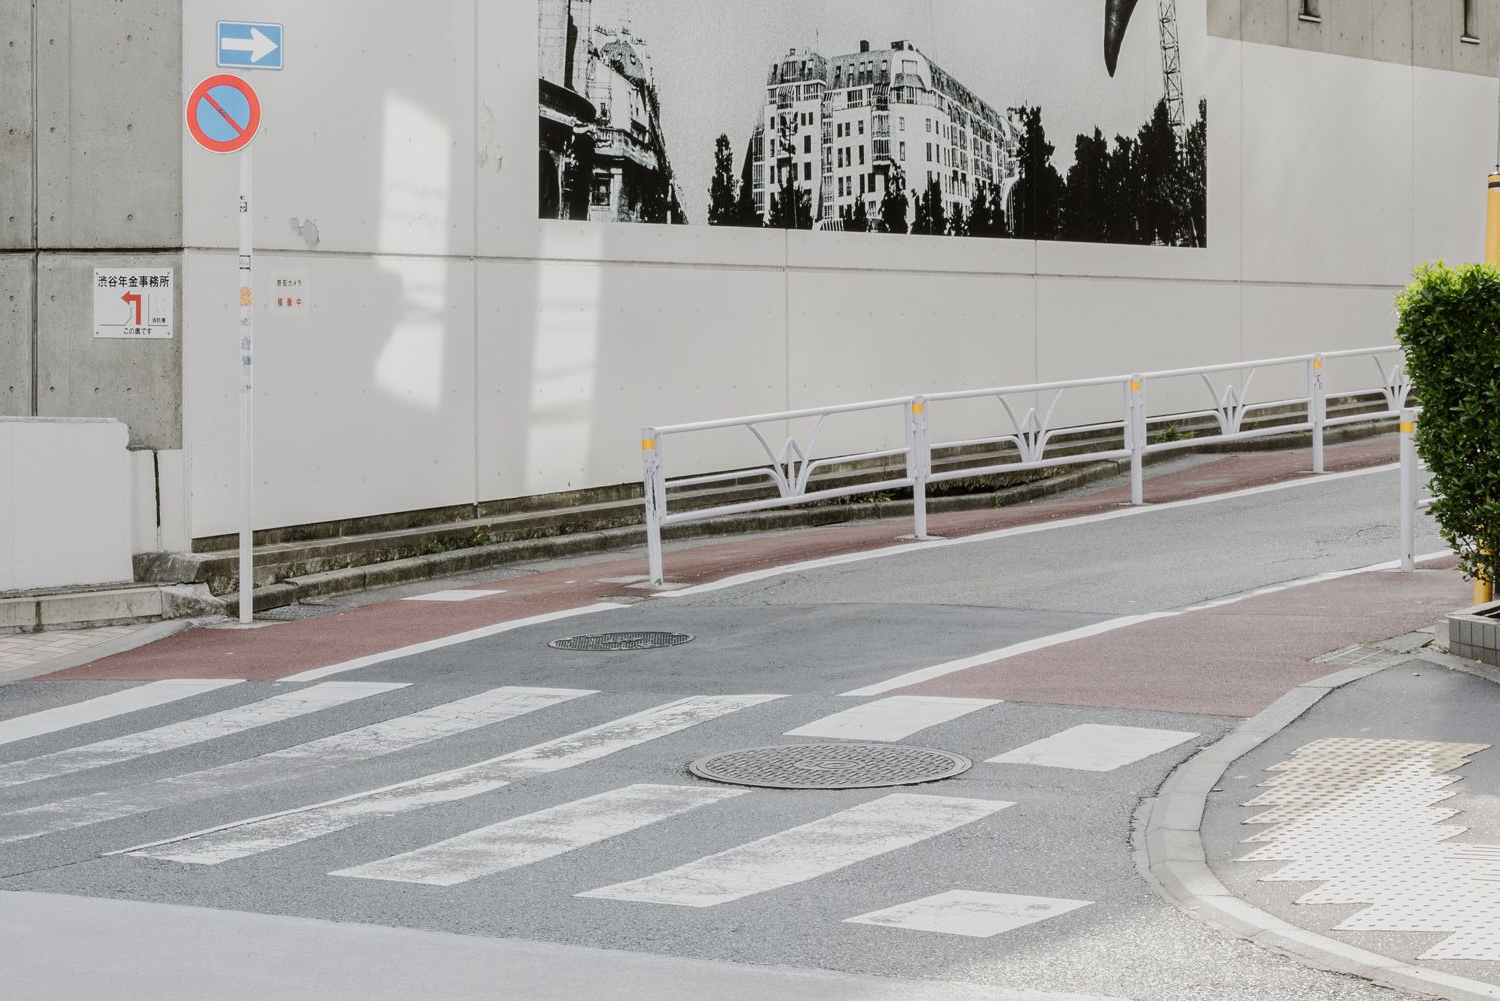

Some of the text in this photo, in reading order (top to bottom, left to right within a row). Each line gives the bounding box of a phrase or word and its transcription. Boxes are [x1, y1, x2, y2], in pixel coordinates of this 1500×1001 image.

[98, 275, 170, 288] 渋谷年金事務所
[123, 327, 152, 335] この奥です
